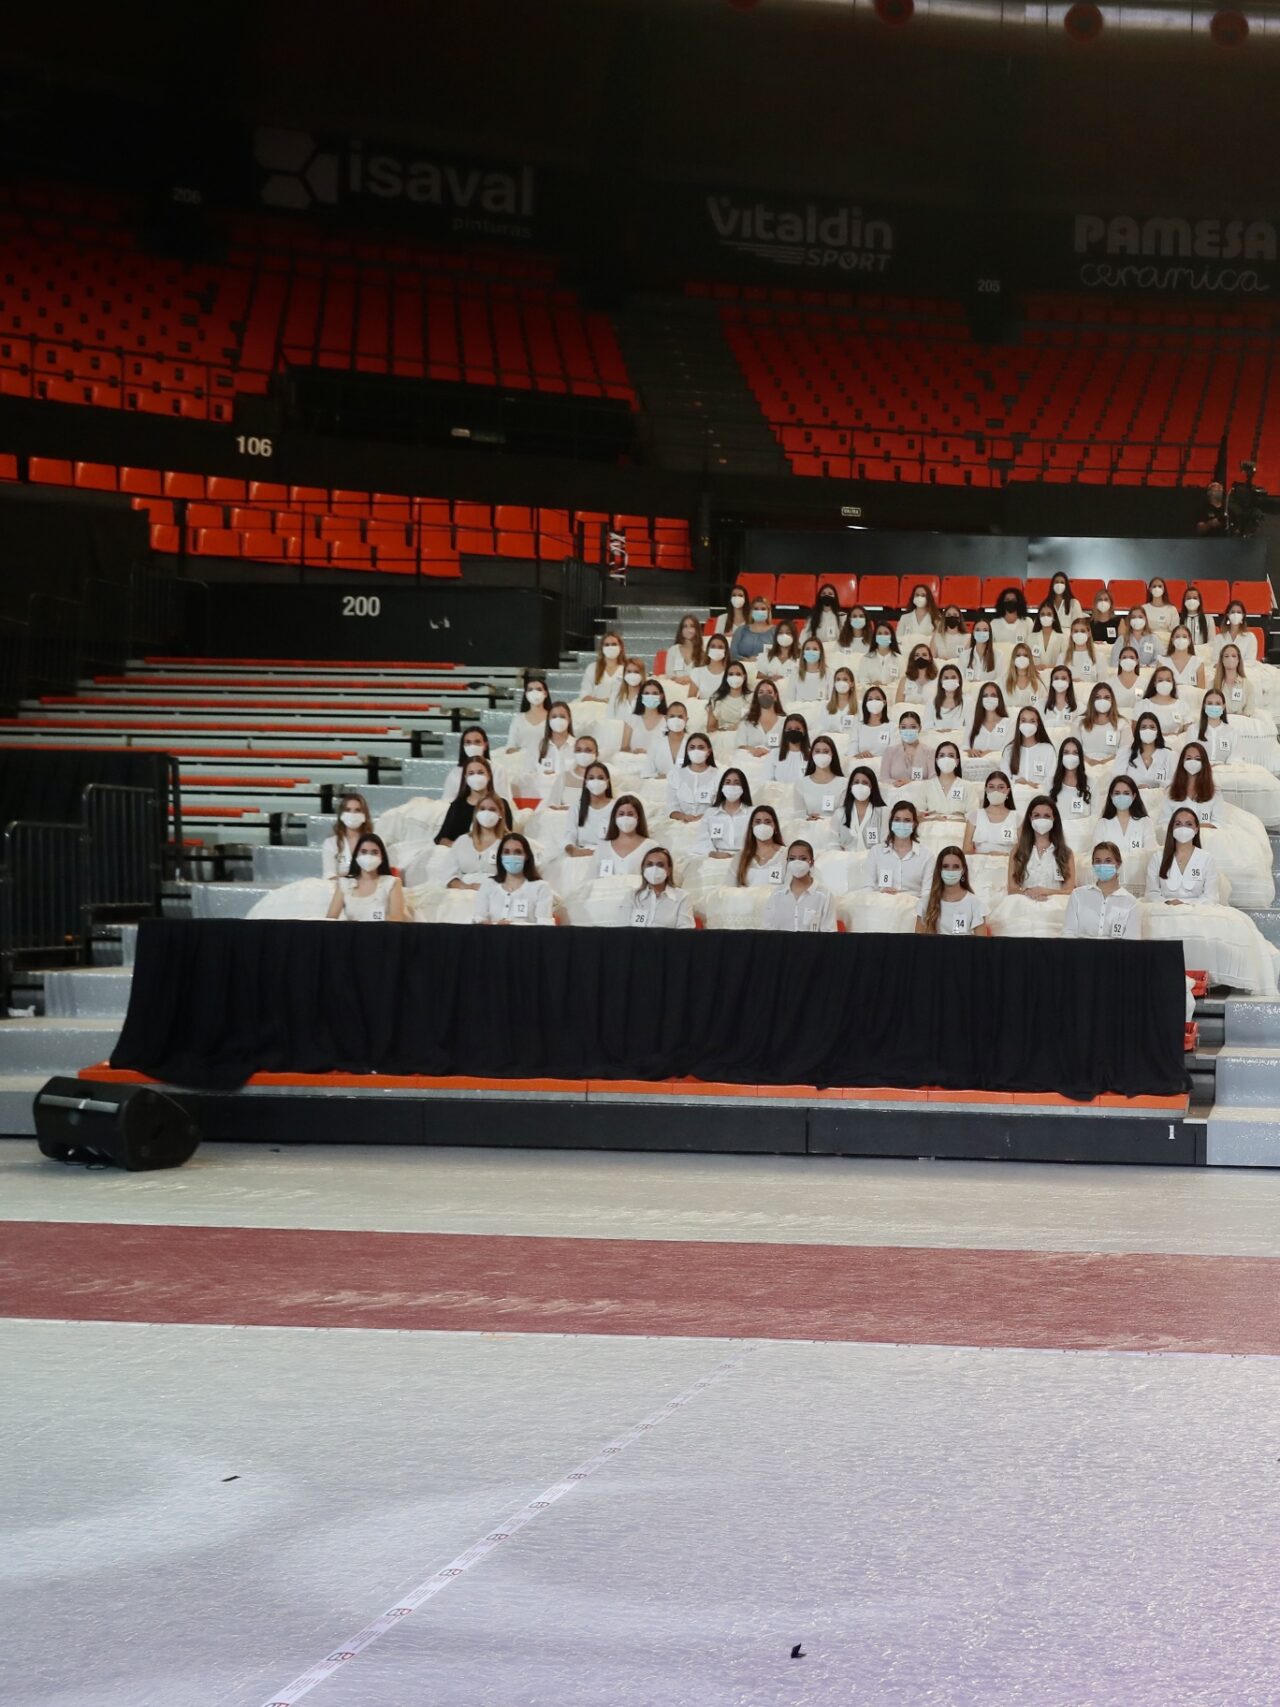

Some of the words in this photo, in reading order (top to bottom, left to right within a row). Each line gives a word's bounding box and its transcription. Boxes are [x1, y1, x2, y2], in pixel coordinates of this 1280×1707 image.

[347, 139, 534, 216] isaval
[451, 217, 533, 239] pinturas
[706, 196, 893, 250] Vitaldin
[1074, 214, 1277, 260] PAMESA
[806, 247, 891, 272] SPORT
[977, 279, 1001, 293] 205
[1080, 263, 1270, 292] ceramica
[236, 435, 273, 457] 106
[342, 596, 381, 616] 200
[884, 874, 888, 882] 8
[635, 914, 645, 922] 26
[1114, 924, 1122, 932] 52
